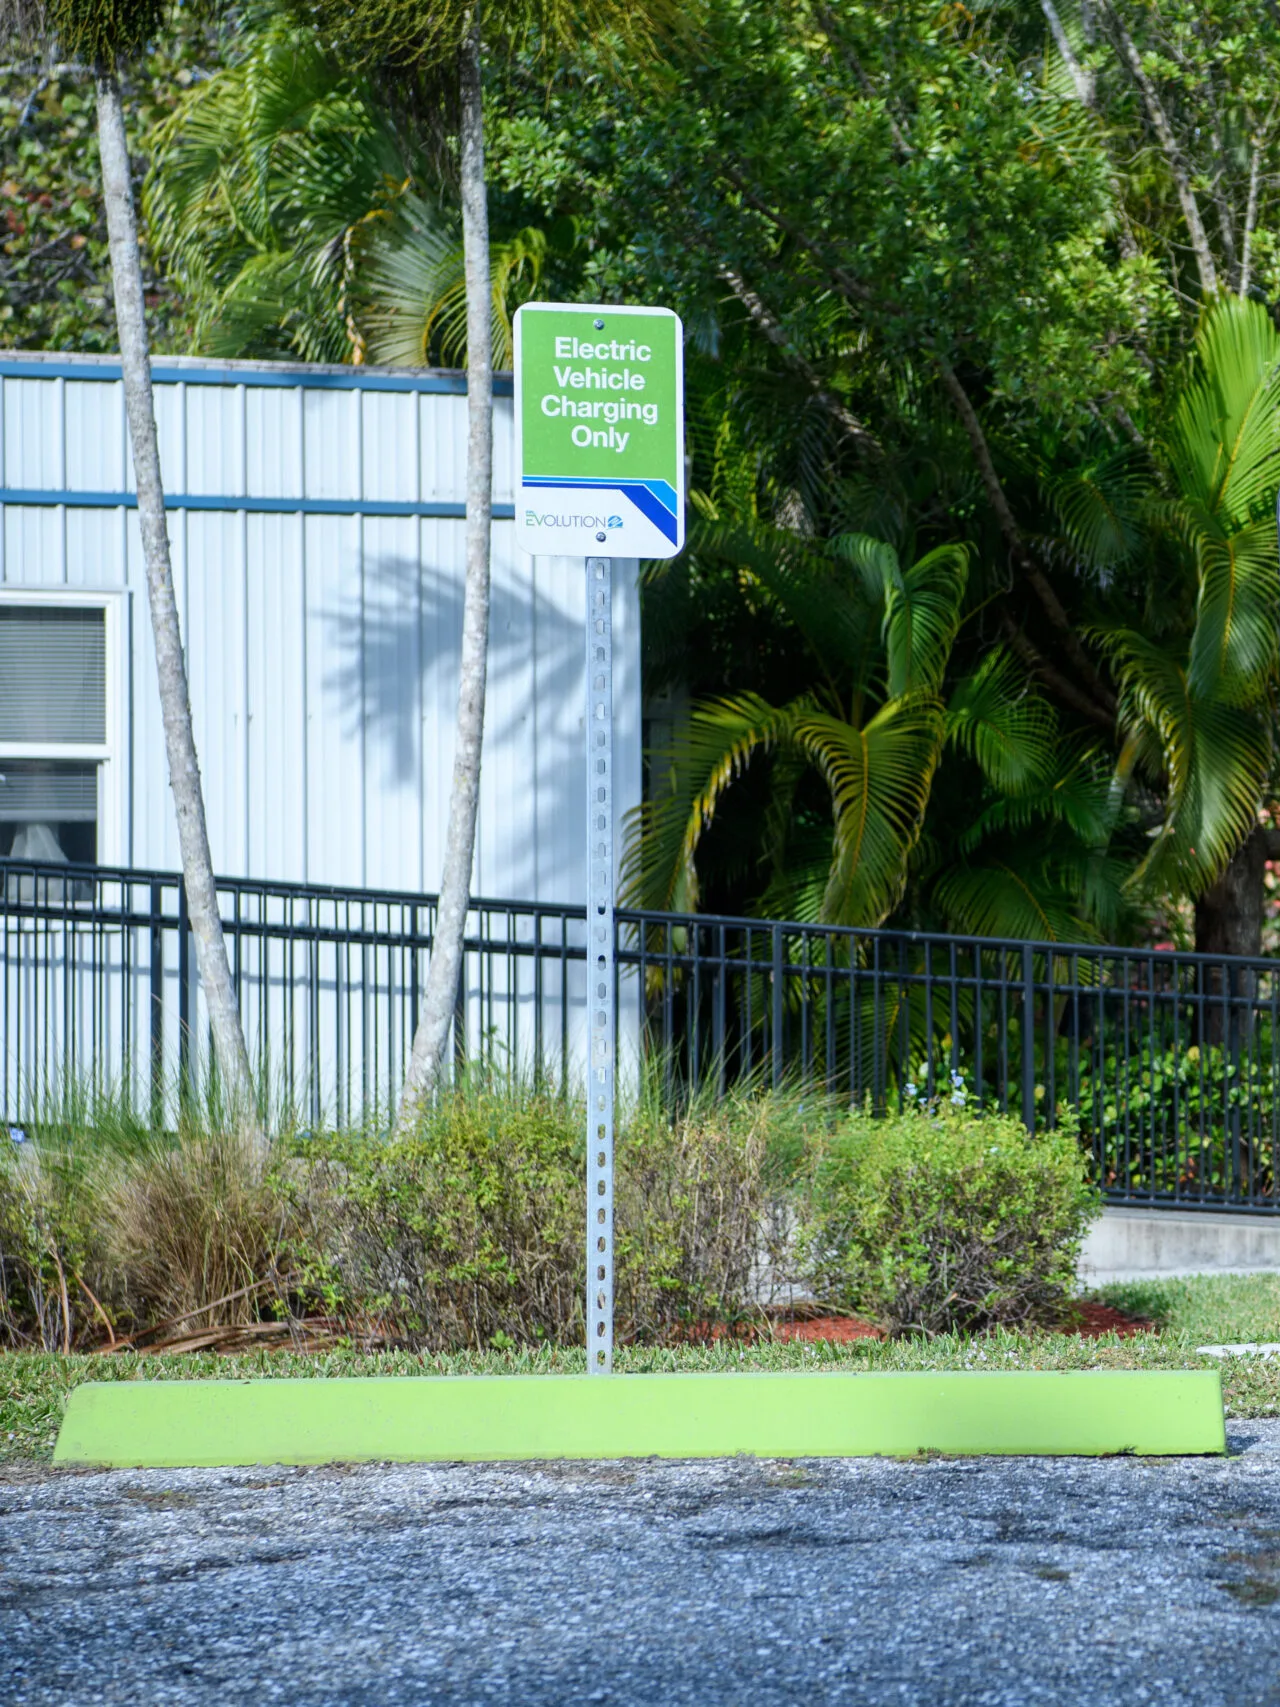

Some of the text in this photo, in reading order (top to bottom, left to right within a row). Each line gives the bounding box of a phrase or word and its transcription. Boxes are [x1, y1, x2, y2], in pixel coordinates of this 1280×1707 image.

[554, 336, 652, 362] Electric
[553, 366, 646, 391] Vehicle
[540, 394, 658, 425] Charging
[571, 425, 630, 453] Only
[525, 513, 606, 529] EVOLUTION
